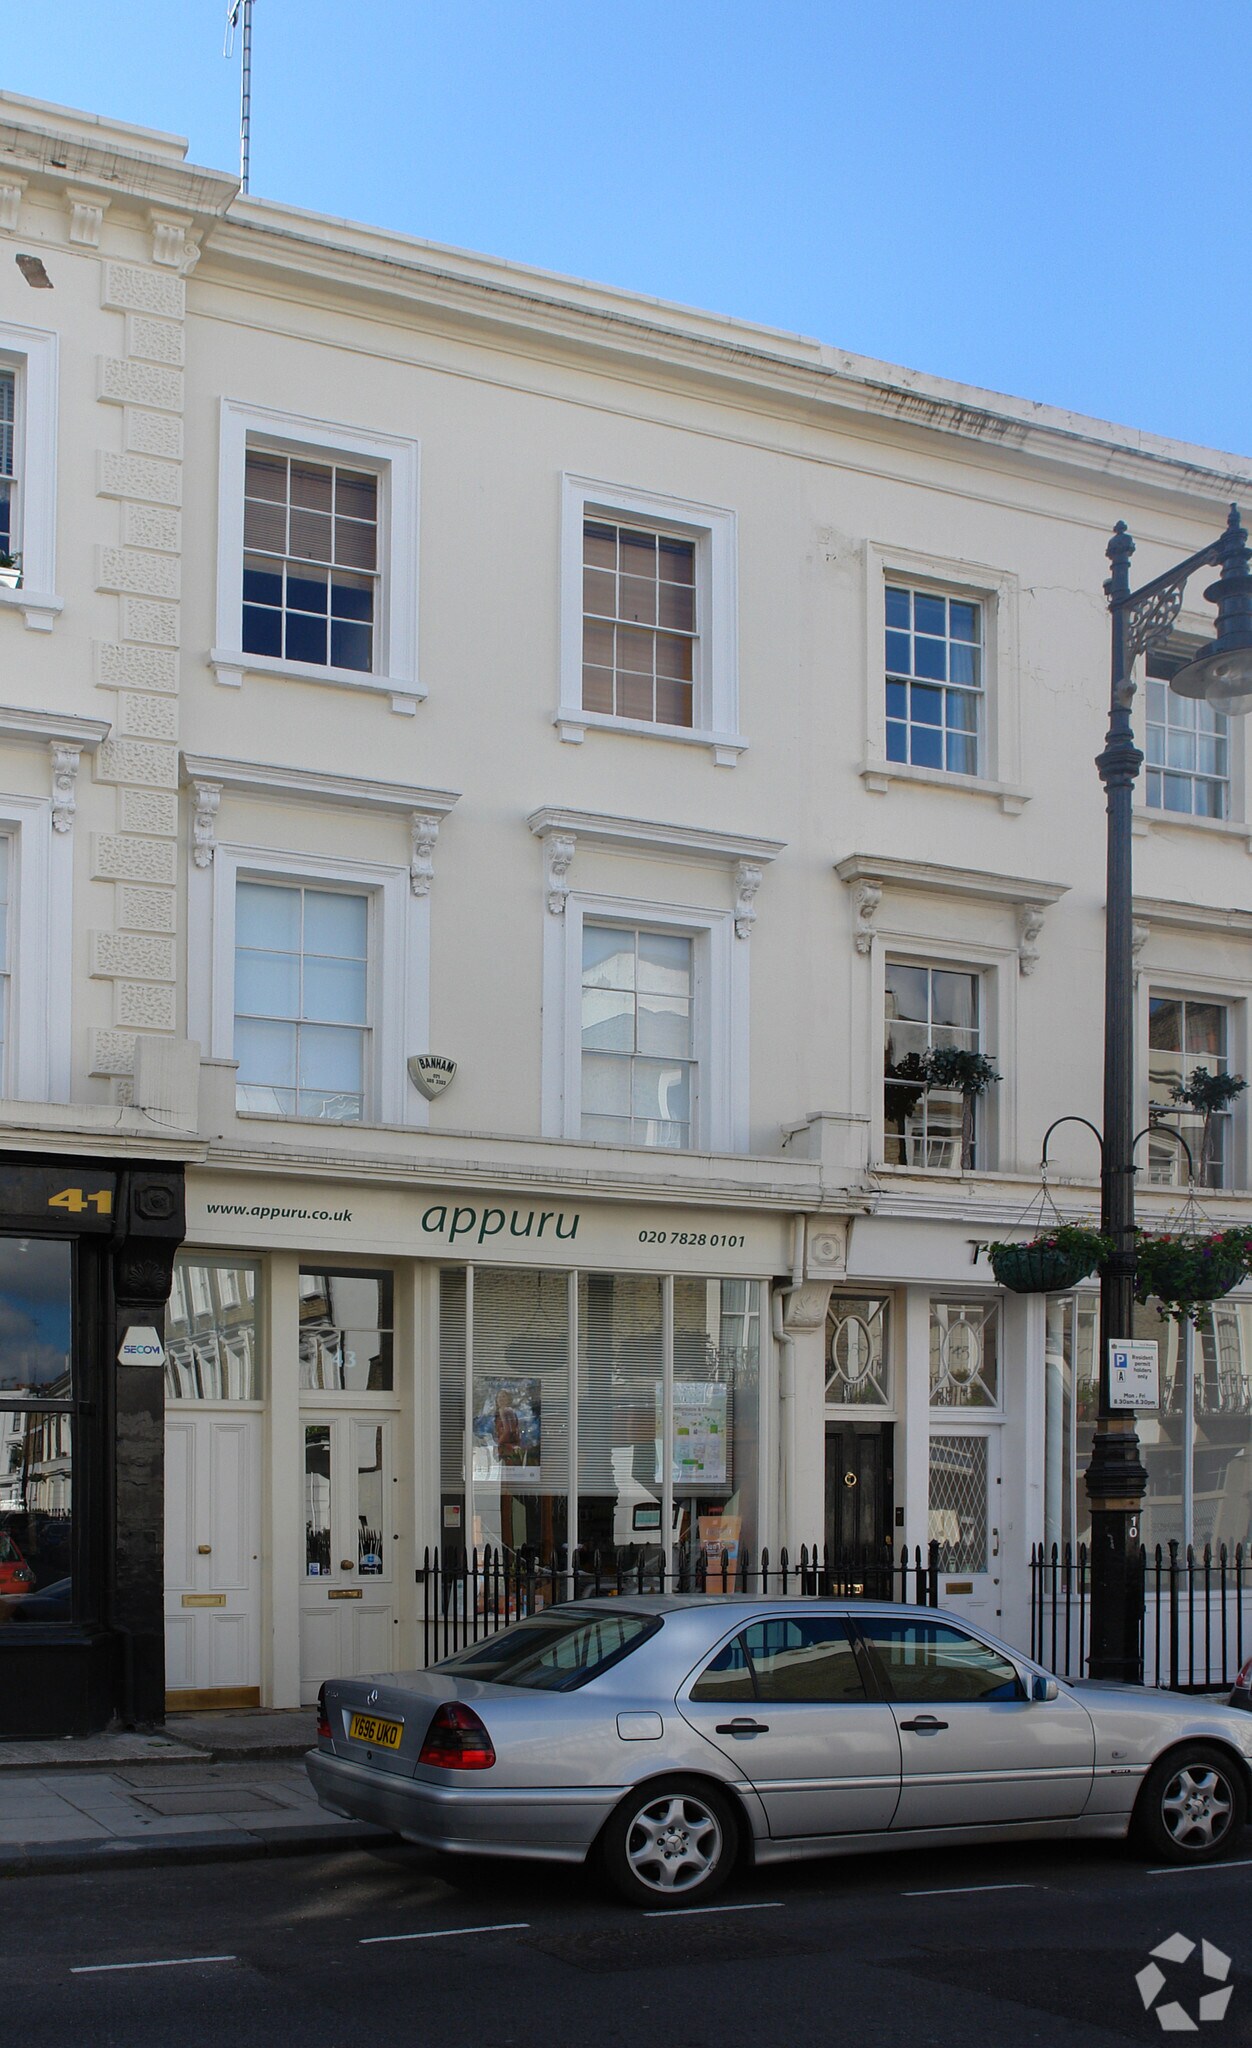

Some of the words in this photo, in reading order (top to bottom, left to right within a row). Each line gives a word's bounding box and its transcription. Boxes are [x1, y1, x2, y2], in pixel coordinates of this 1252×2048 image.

[419, 1057, 454, 1073] BANHAM
[48, 1188, 112, 1214] 41
[206, 1203, 353, 1222] www.appuru.co.uk
[420, 1205, 581, 1244] appuru
[638, 1230, 666, 1244] 020
[669, 1232, 707, 1247] 7828
[709, 1234, 746, 1249] 0101
[123, 1345, 160, 1355] SECOM
[332, 1347, 356, 1368] 43
[1118, 1371, 1124, 1381] A
[354, 1717, 376, 1738] Y696
